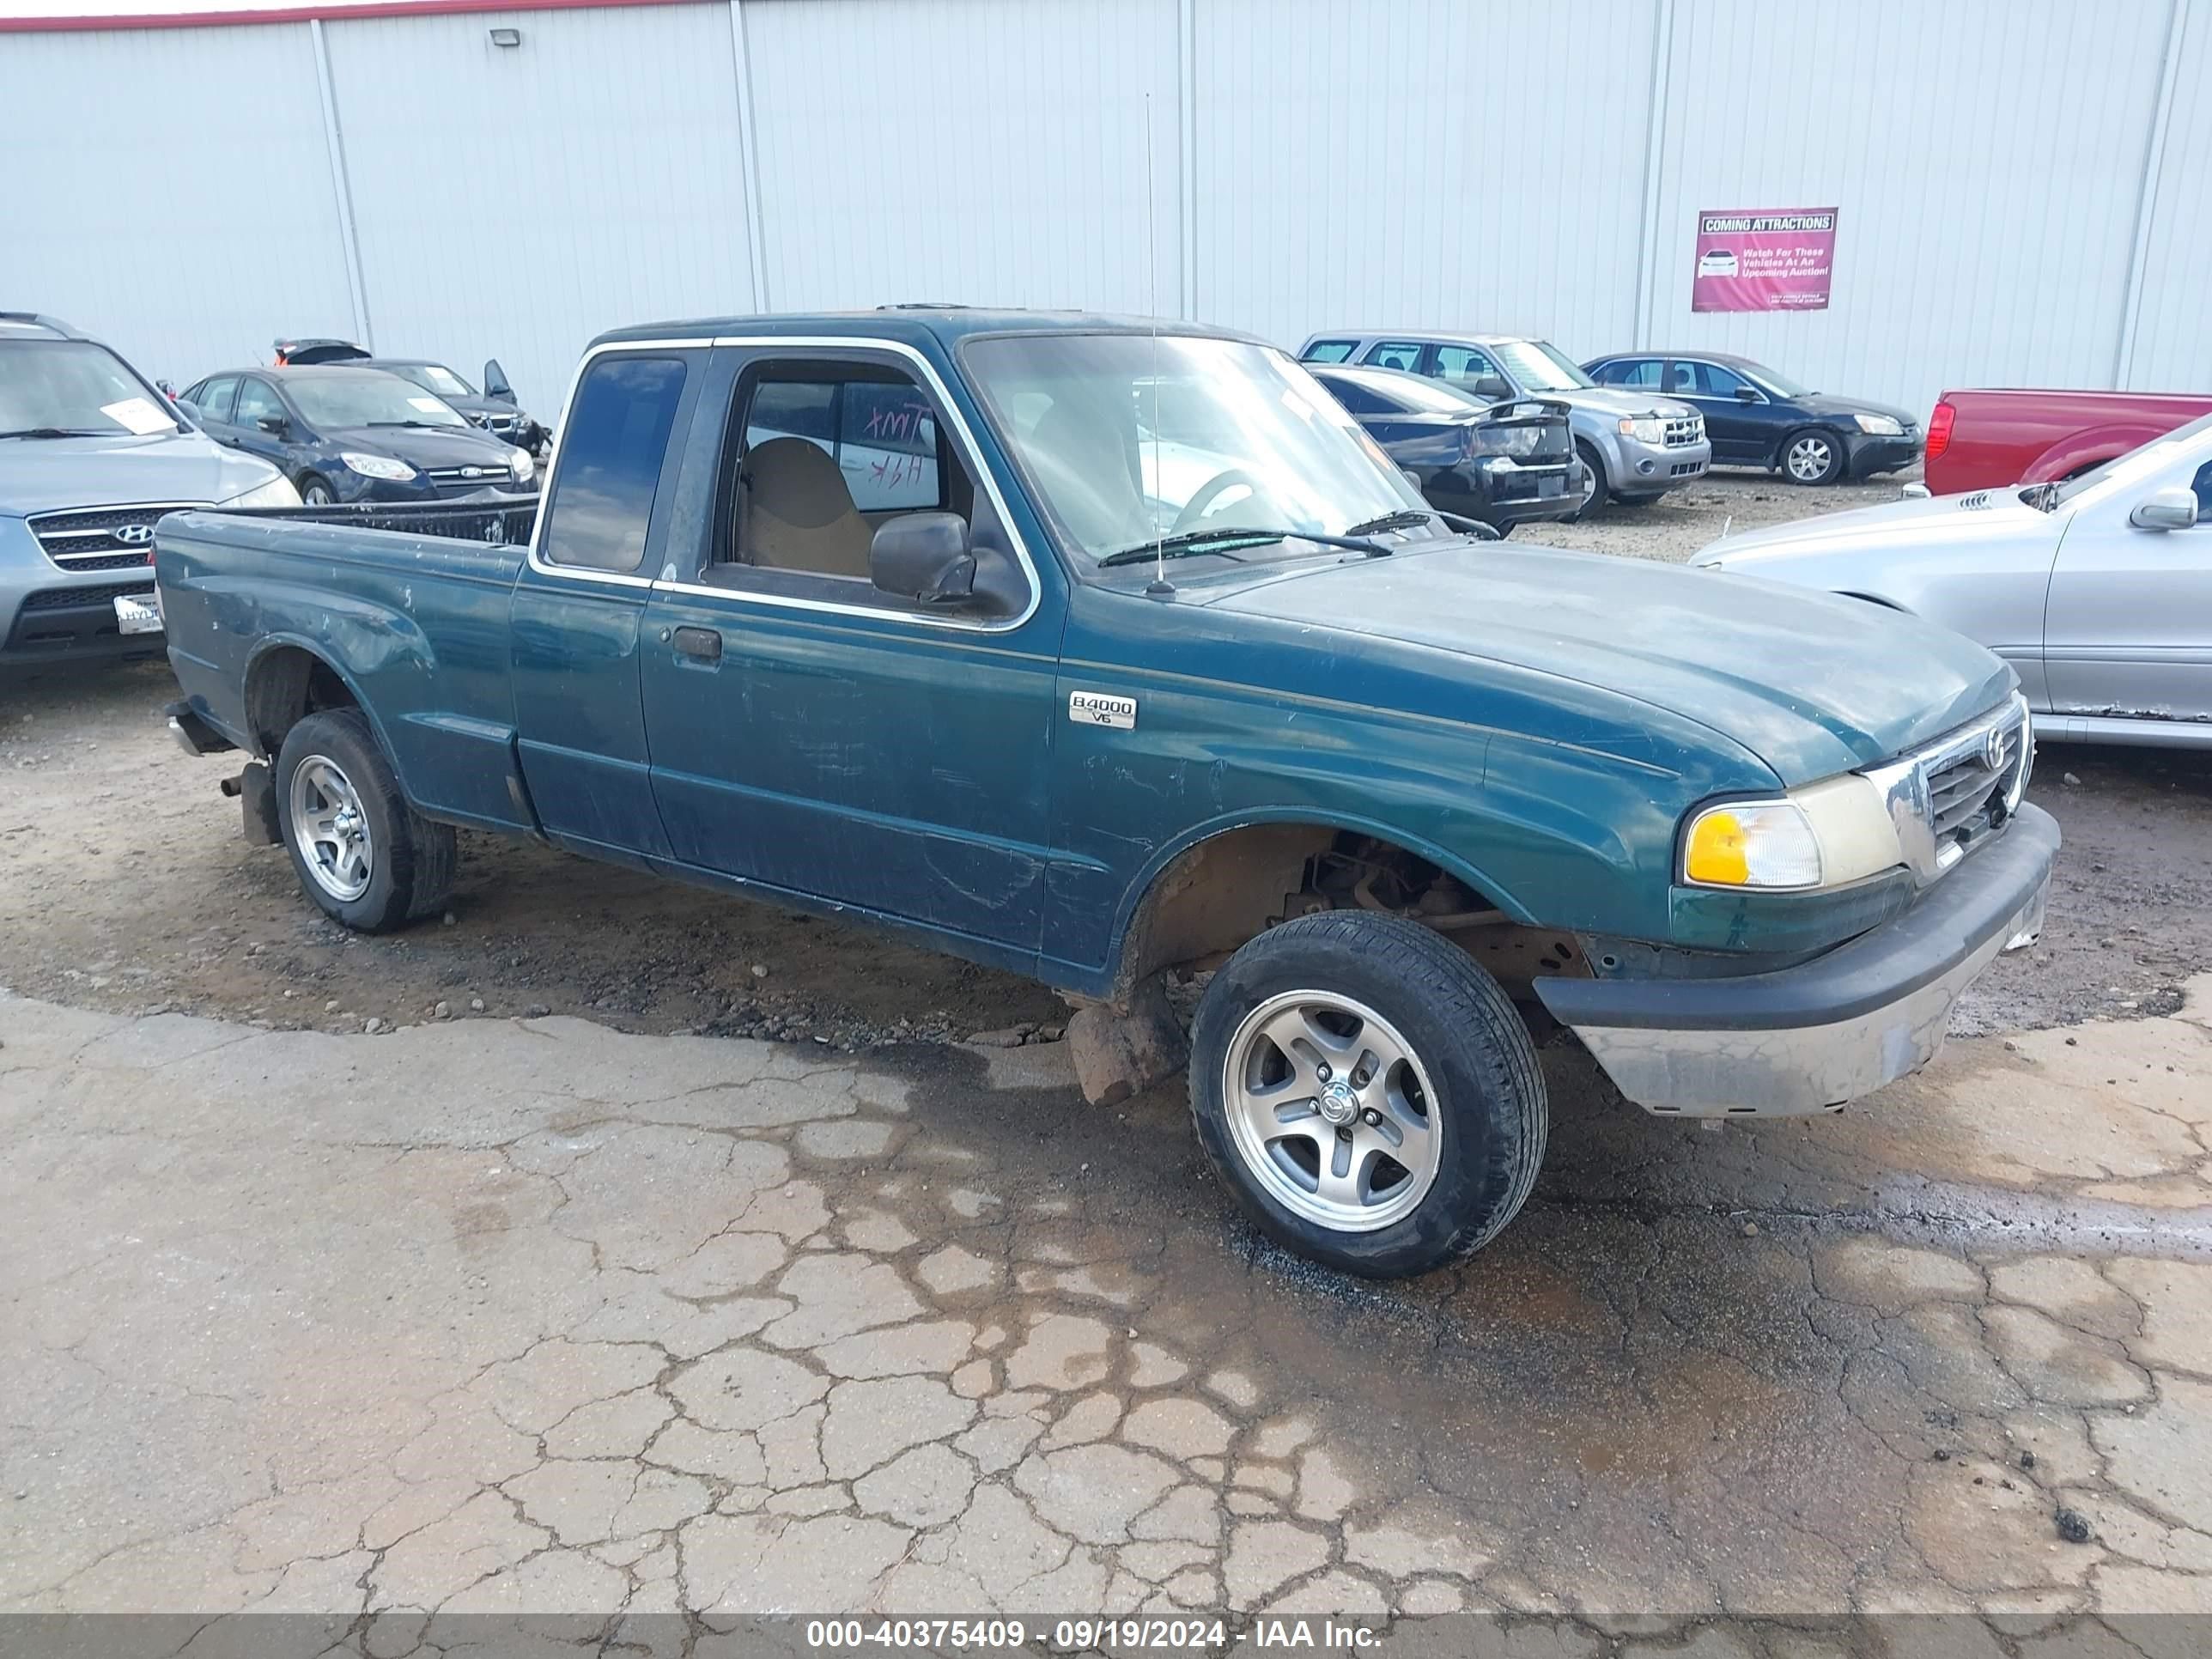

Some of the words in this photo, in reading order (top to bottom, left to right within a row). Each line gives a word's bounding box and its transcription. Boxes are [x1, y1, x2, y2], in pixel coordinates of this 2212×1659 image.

[1705, 218, 1751, 232] COMING
[1752, 216, 1830, 231] ATTRACTIONS
[1743, 248, 1773, 257] Watch
[1776, 247, 1792, 257] For
[1794, 247, 1824, 256] These
[1743, 258, 1784, 267] Vehicles
[1785, 258, 1797, 266] At
[1800, 257, 1814, 266] An
[1742, 267, 1788, 278] Upcoming
[1789, 266, 1829, 276] Auction!
[1073, 696, 1132, 714] B4000
[1091, 712, 1112, 723] V6
